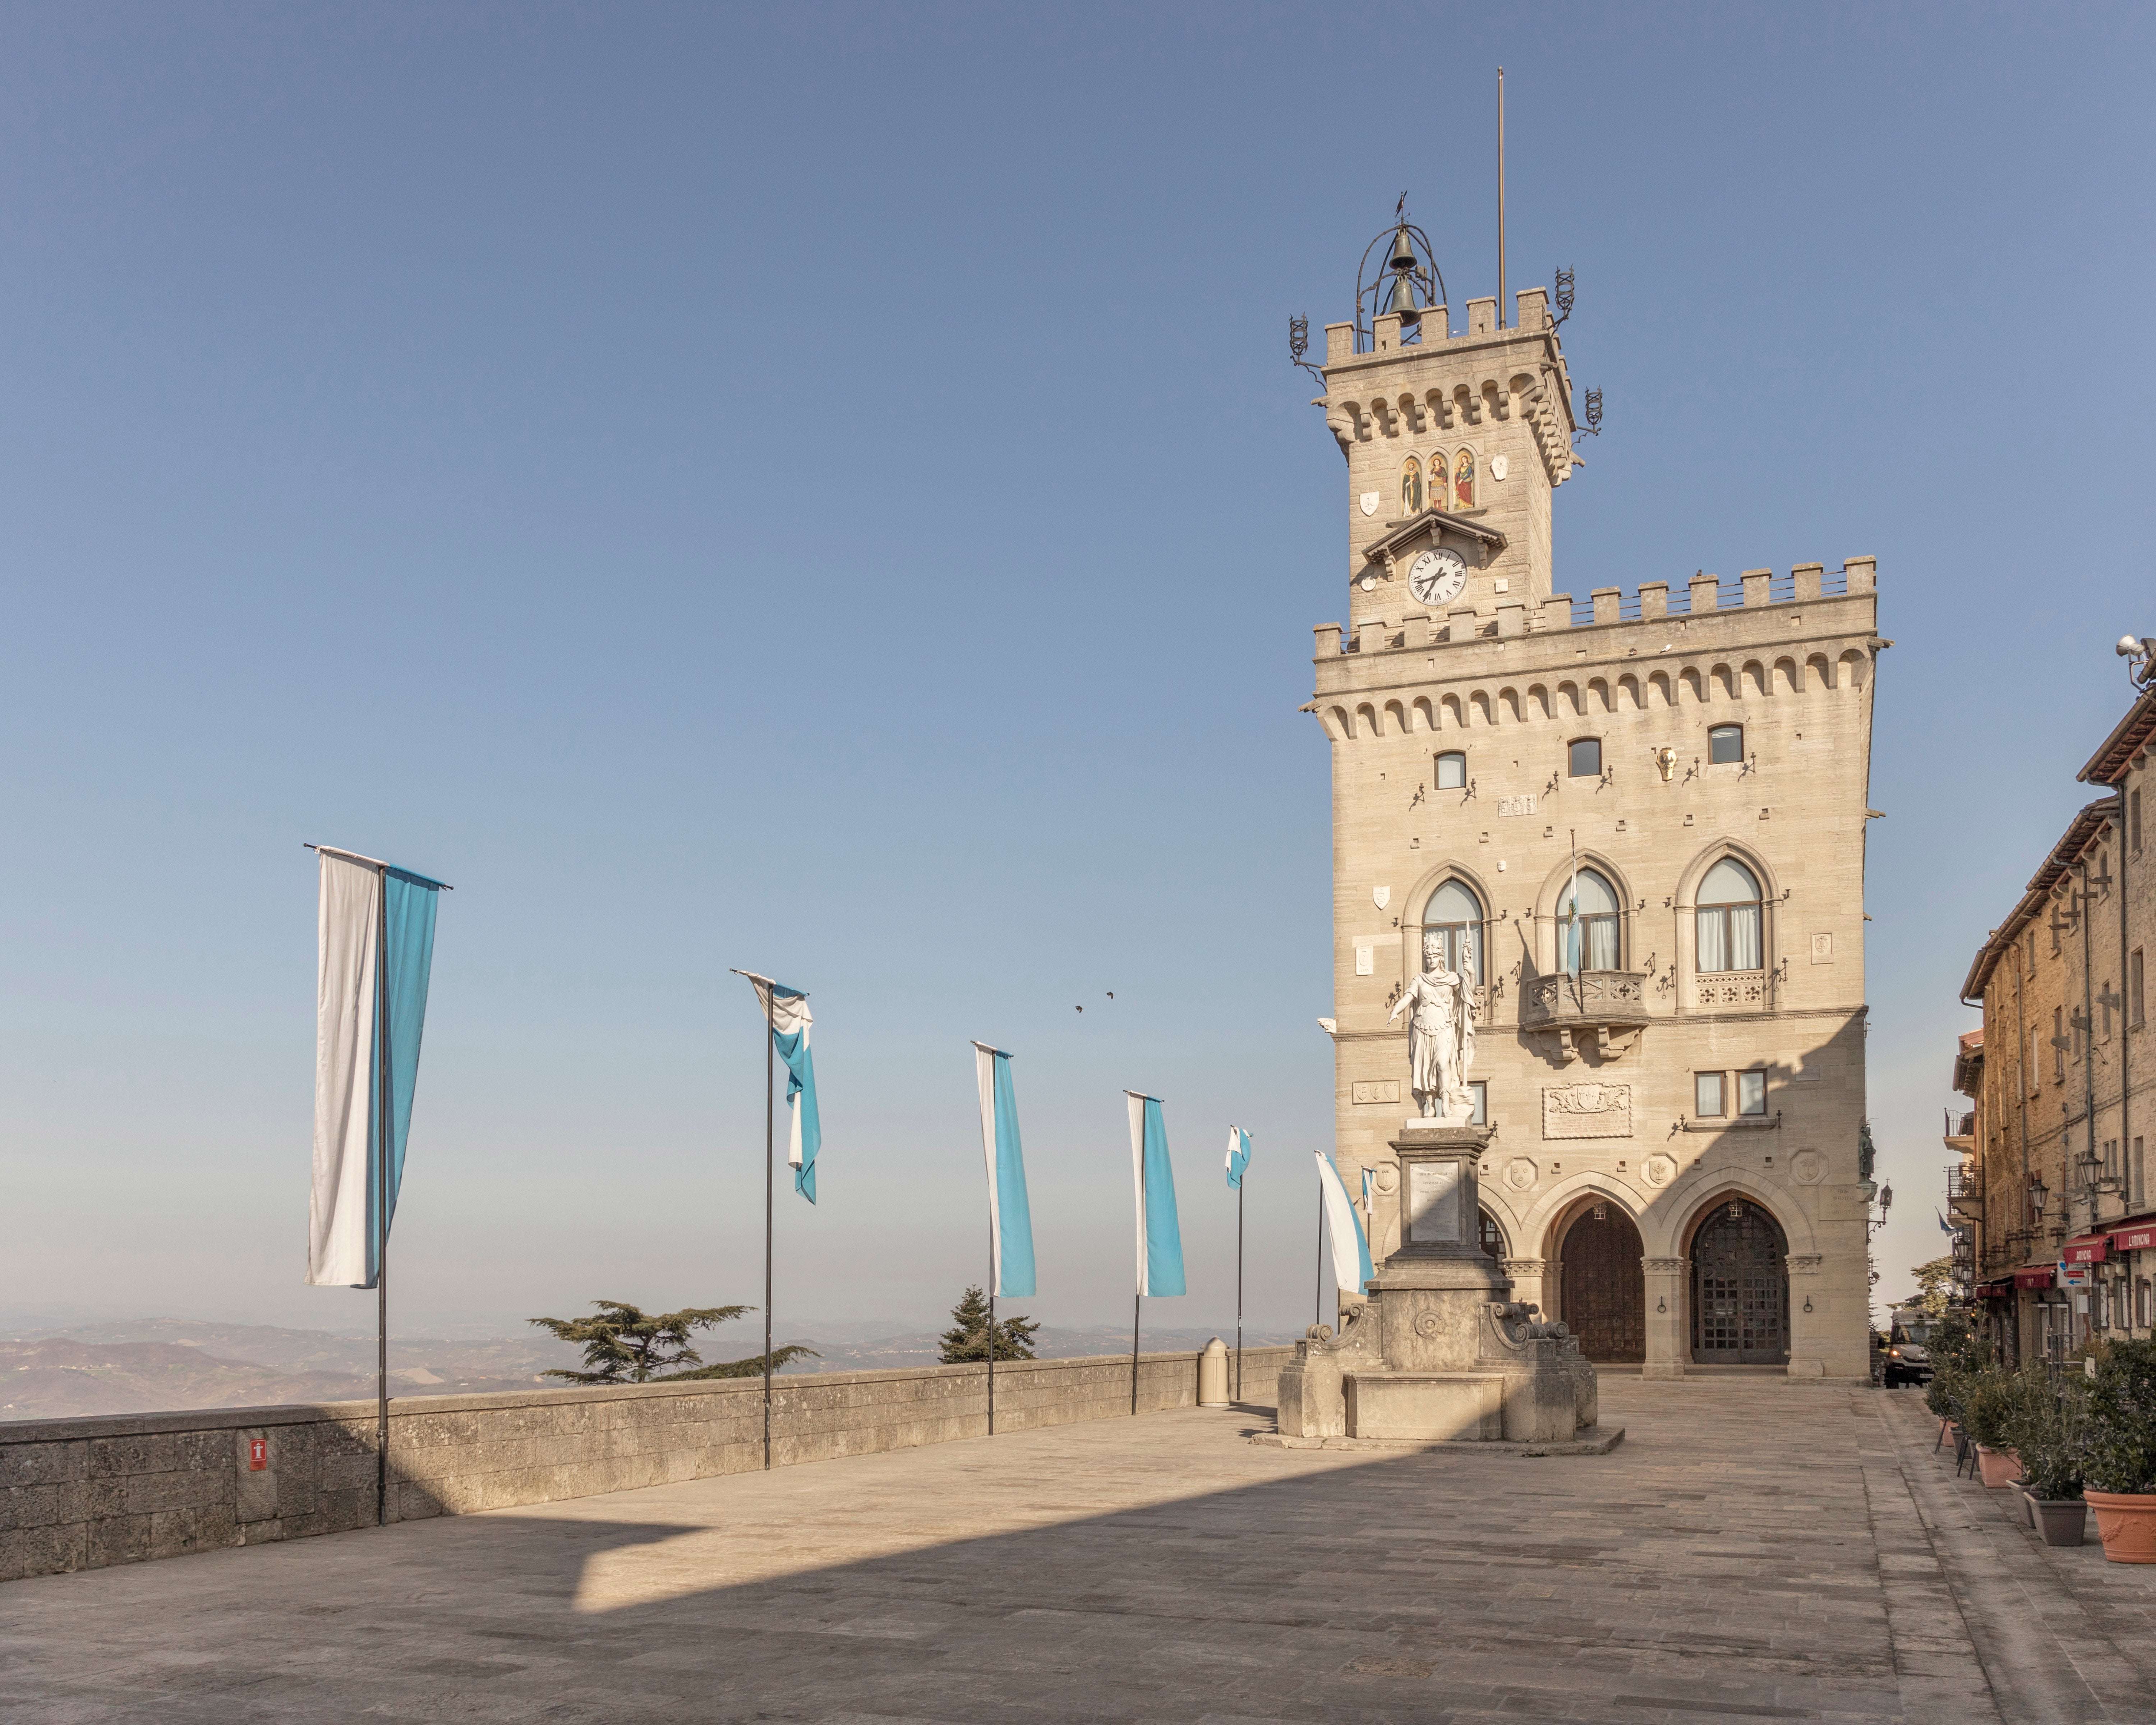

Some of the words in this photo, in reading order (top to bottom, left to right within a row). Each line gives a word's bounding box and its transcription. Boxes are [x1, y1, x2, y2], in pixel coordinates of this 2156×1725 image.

[1422, 556, 1431, 566] XI
[1433, 552, 1443, 561] XII
[1415, 584, 1425, 595] VIII
